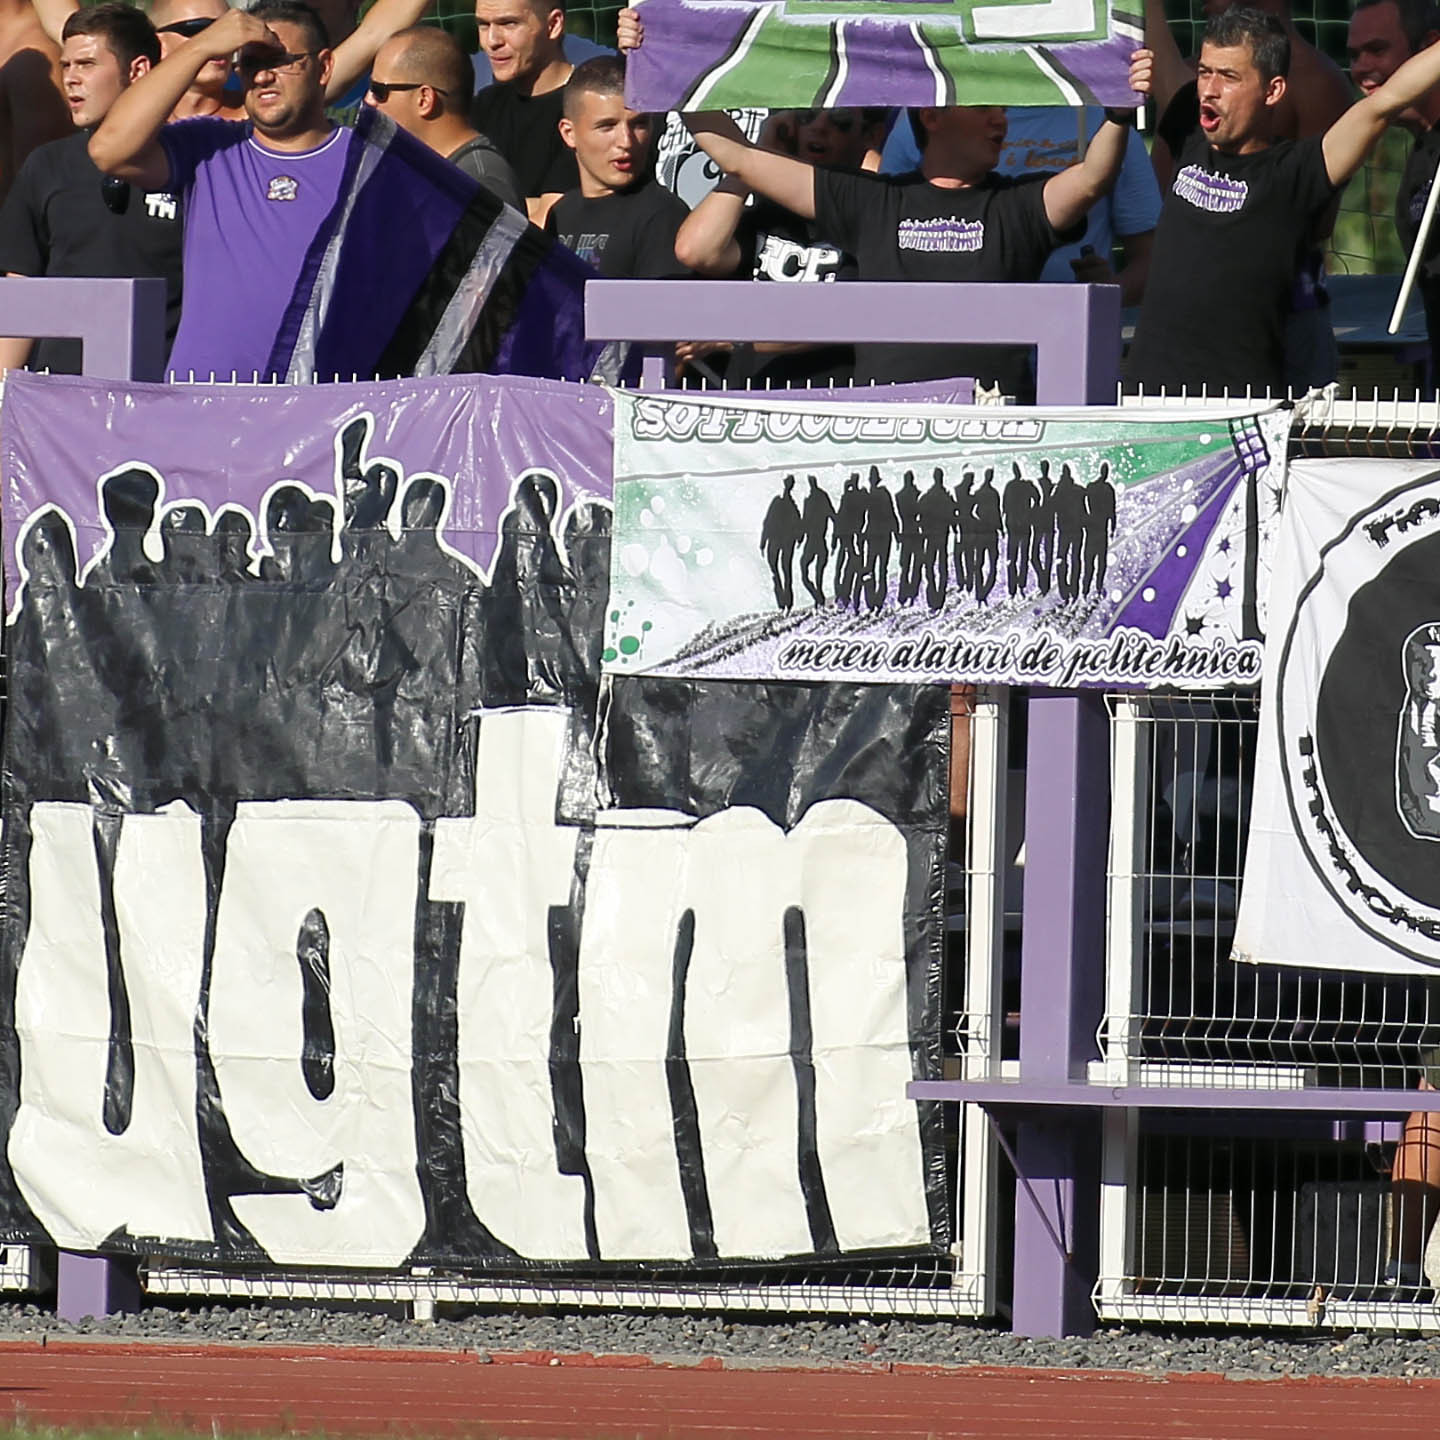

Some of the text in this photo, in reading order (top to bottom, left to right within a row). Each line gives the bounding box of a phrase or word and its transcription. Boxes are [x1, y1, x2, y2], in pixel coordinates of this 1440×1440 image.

[781, 630, 1260, 687] mereu alaturi de politehnica
[7, 710, 932, 1268] ugtm
